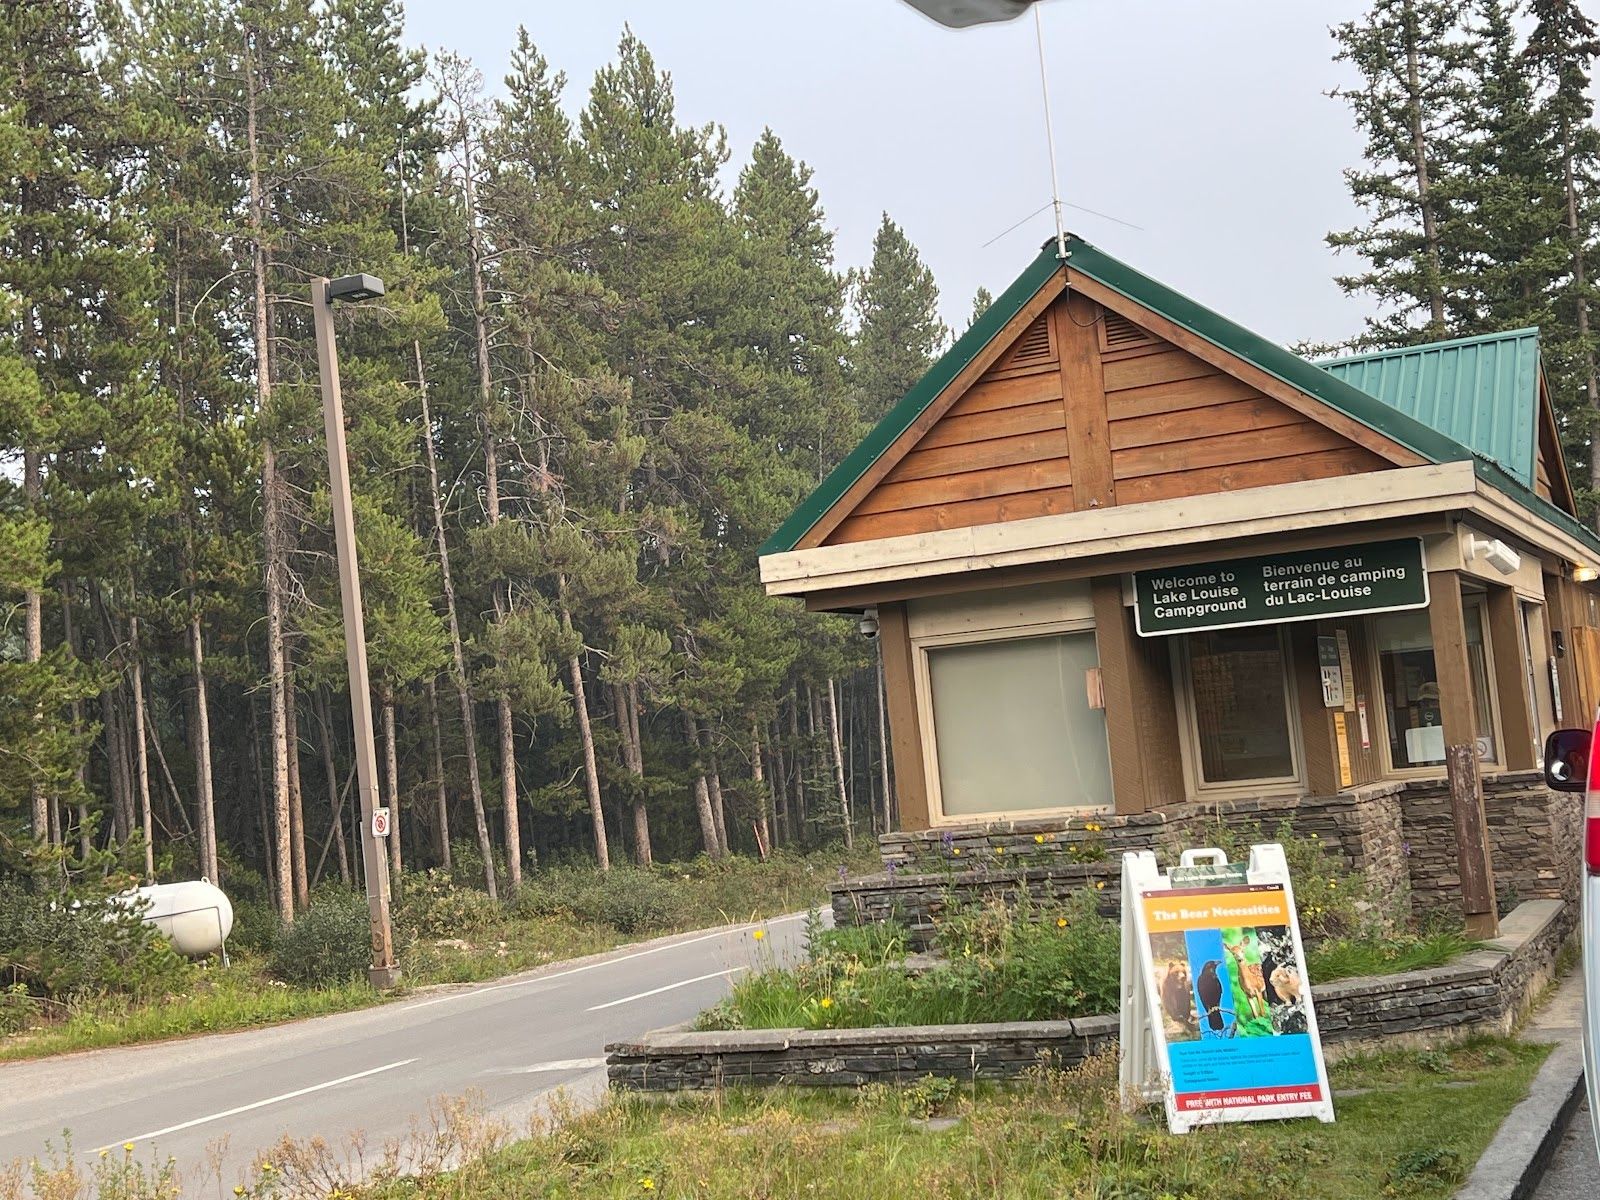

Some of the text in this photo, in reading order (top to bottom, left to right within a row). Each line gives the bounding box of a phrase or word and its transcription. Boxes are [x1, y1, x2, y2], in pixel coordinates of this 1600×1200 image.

[1262, 557, 1363, 577] Bienvenue au
[1151, 571, 1235, 591] Welcome to
[1263, 567, 1406, 592] terrain de camping
[1153, 586, 1239, 604] Lake Louise
[1265, 585, 1372, 606] du Lac-Louise
[1154, 598, 1247, 618] Campground
[1153, 904, 1280, 921] The Bear Necessities
[1186, 1091, 1313, 1108] FREE WITH NATIONAL PARK ENTRY FEE
